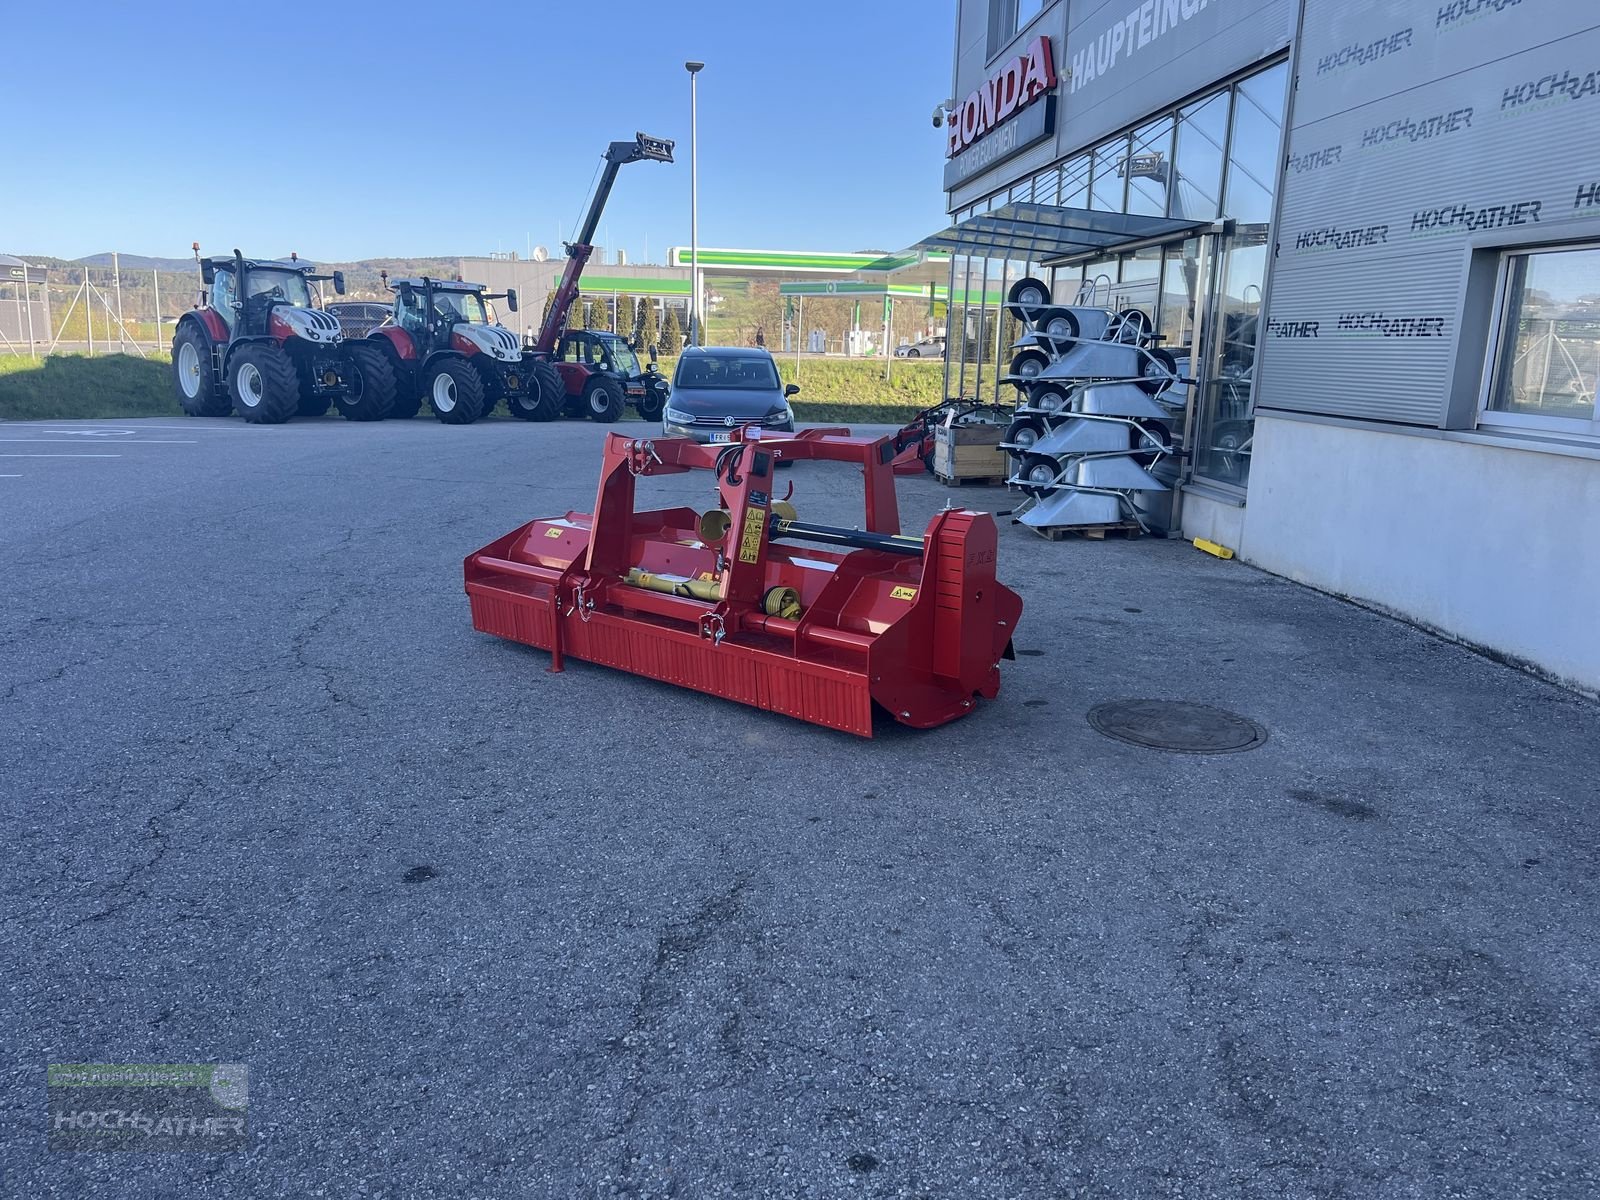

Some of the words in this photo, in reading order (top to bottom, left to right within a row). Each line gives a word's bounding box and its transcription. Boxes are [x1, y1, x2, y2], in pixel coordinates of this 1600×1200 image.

[1316, 27, 1413, 76] HOCHRATHER
[946, 35, 1054, 154] HONDA
[1361, 107, 1474, 149] HOCHRATHER
[1410, 200, 1542, 231] HOCHRATHER
[1296, 224, 1389, 250] HOCHRATHER
[1338, 312, 1444, 337] HOCHRATHER
